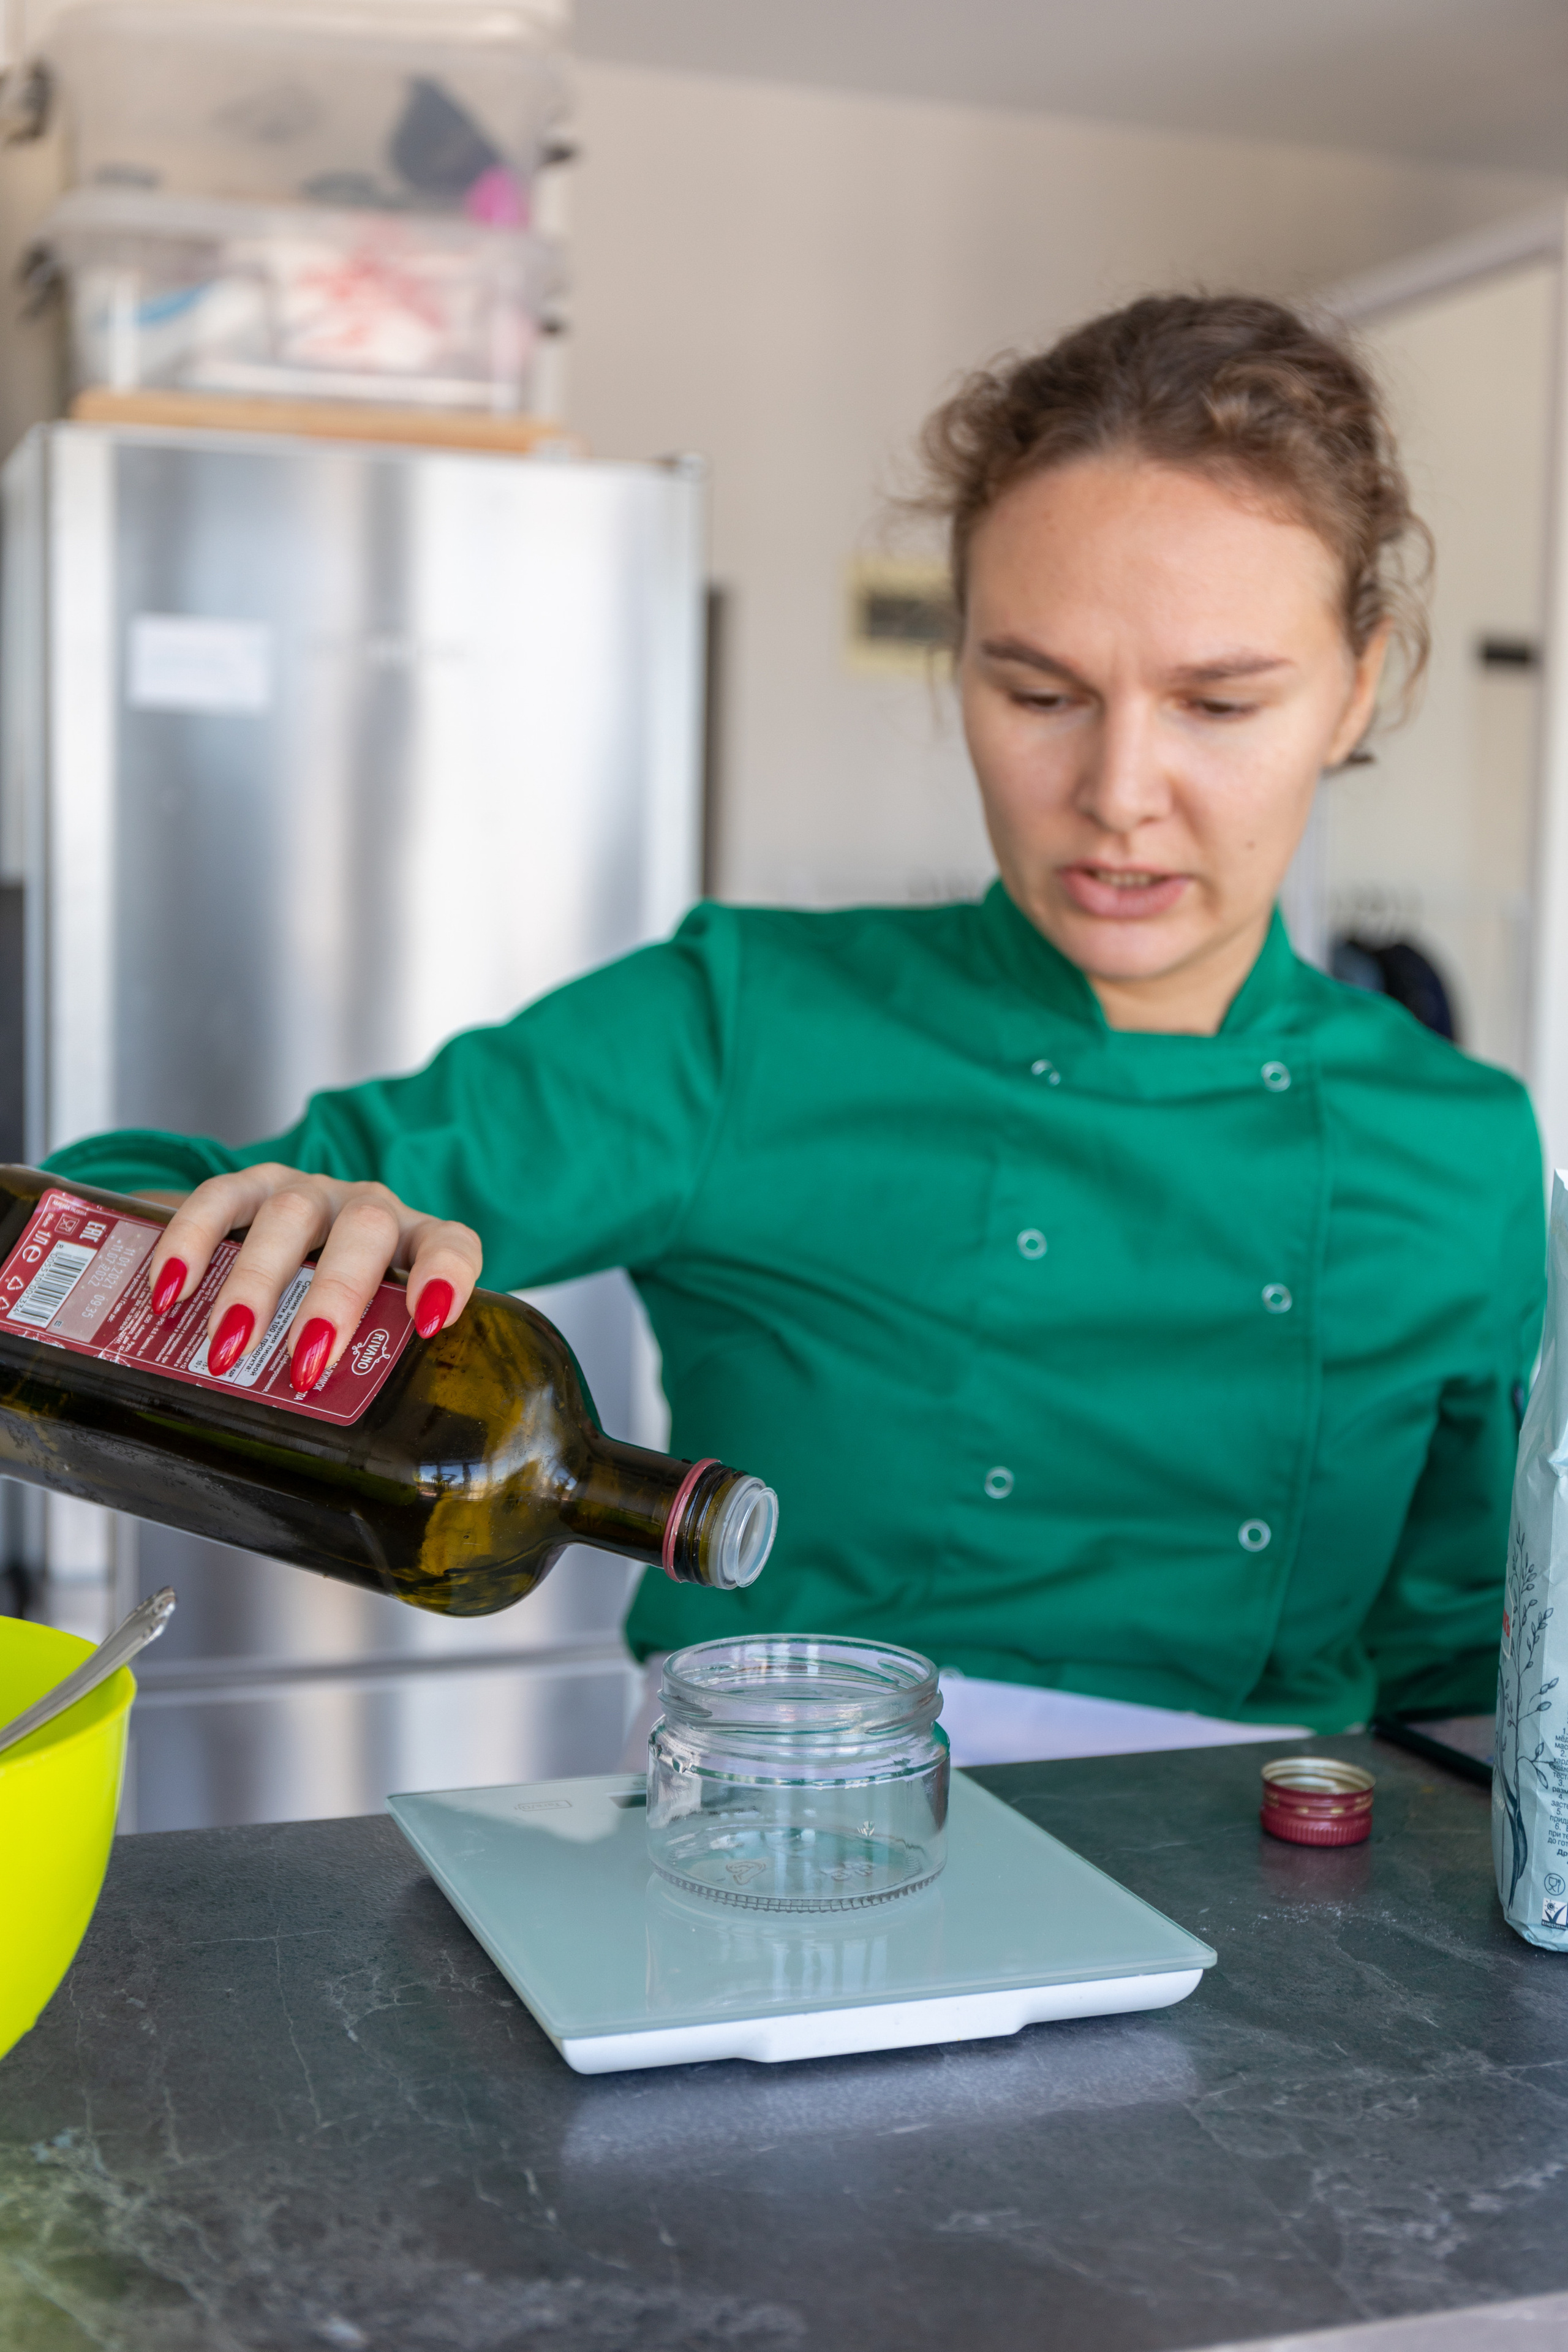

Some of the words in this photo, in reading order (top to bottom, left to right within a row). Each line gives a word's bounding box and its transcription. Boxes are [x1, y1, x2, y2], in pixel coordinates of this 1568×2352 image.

[281, 1280, 302, 1313] ценности
[290, 1281, 311, 1310] Средние
[269, 1321, 279, 1332] 100
[271, 1312, 292, 1343] значения
[233, 1357, 244, 1368] 3700
[245, 1338, 268, 1371] продукта:
[250, 1345, 271, 1375] пищевой
[357, 1333, 385, 1370] RIVANO
[1555, 1822, 1561, 1831] 6.
